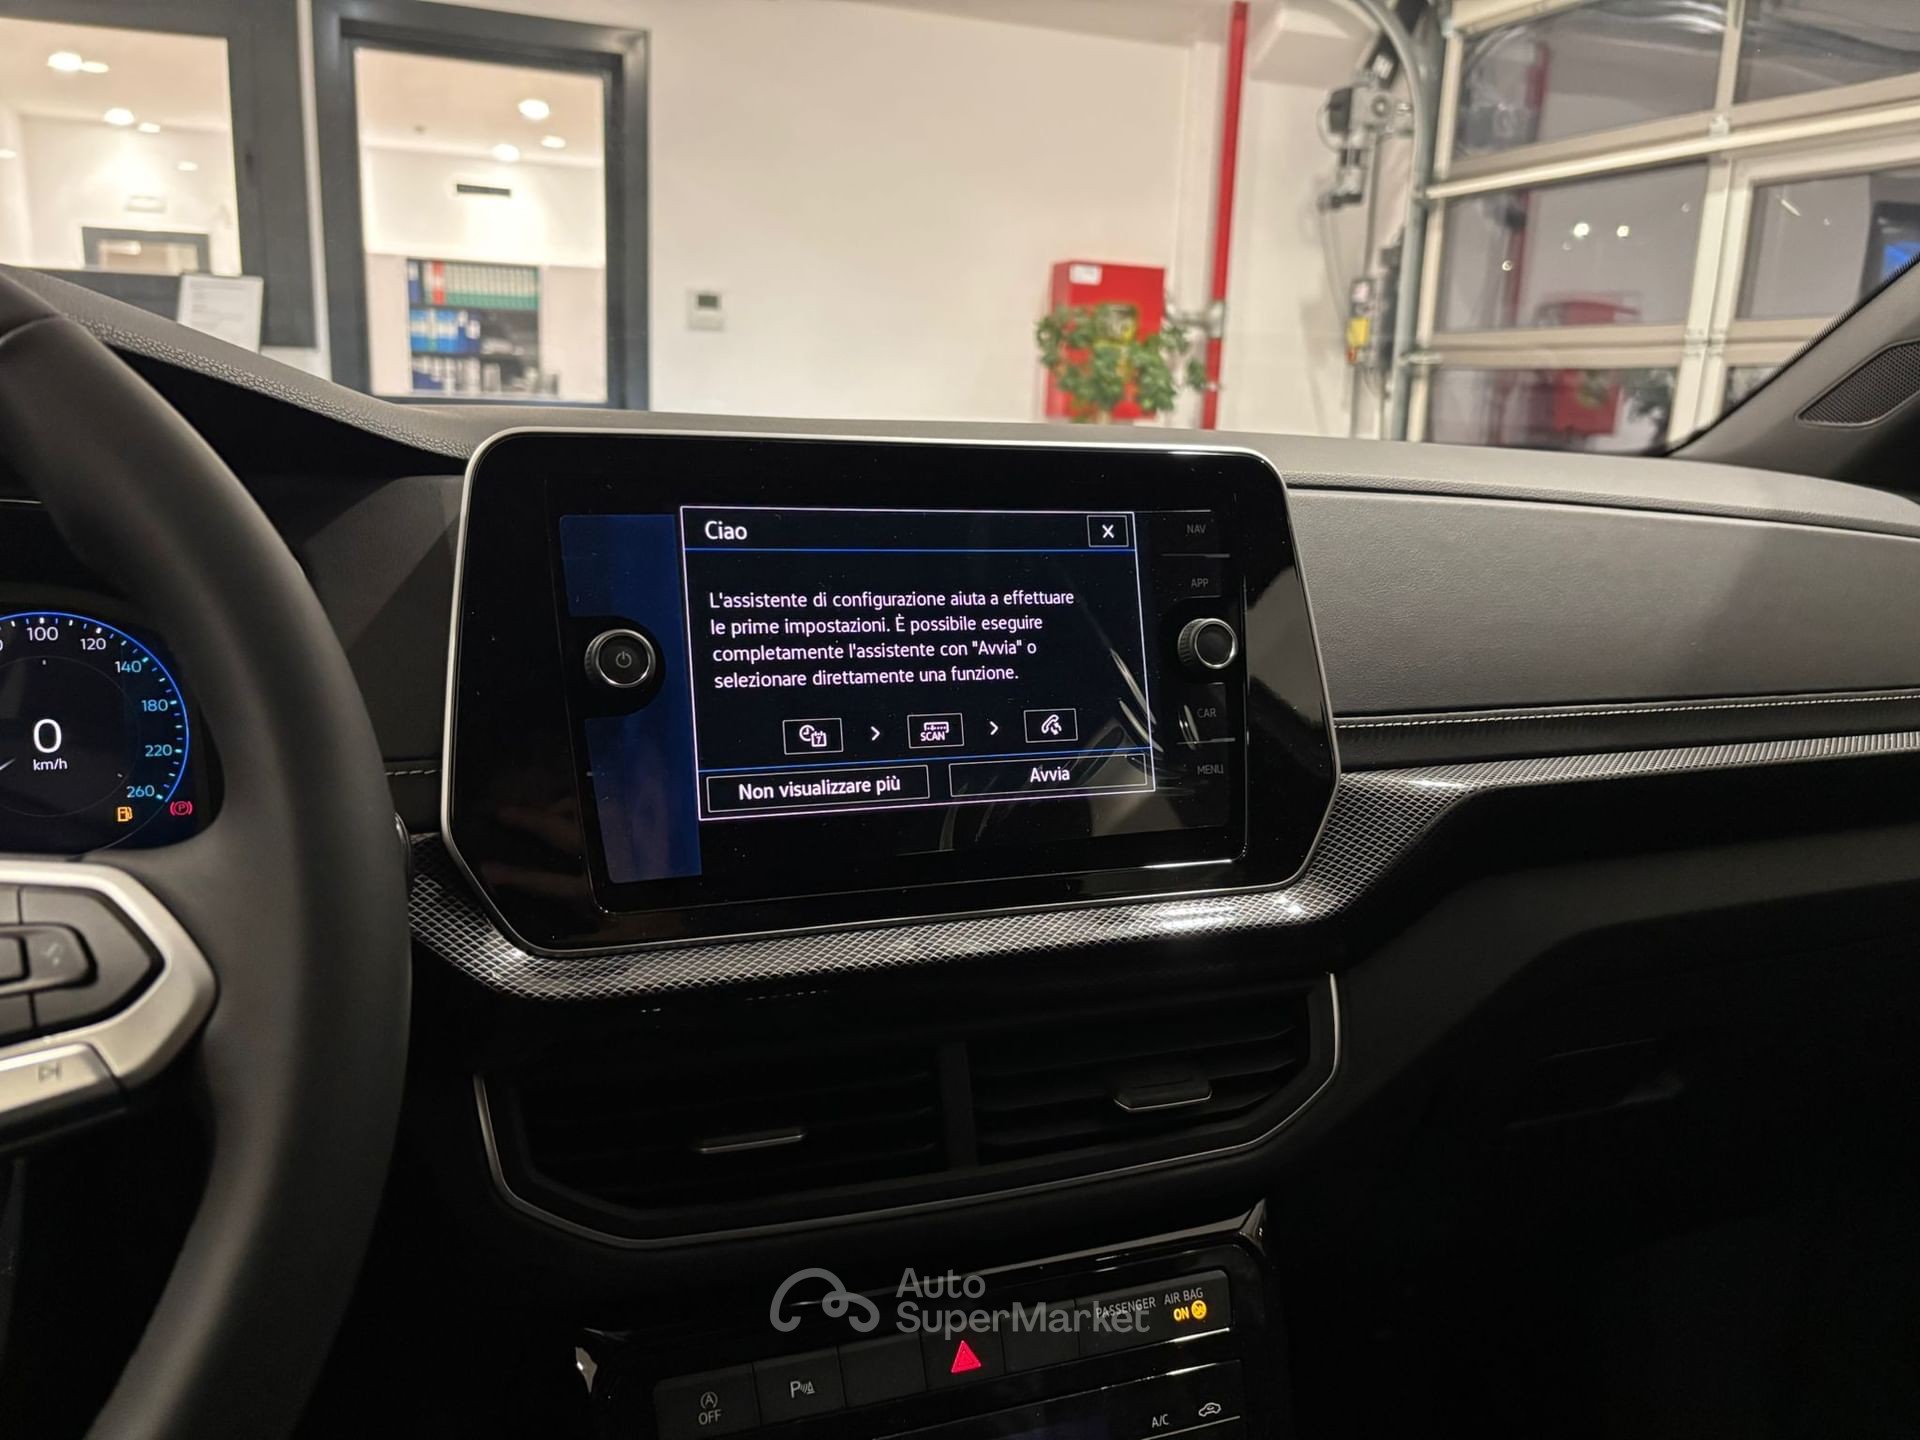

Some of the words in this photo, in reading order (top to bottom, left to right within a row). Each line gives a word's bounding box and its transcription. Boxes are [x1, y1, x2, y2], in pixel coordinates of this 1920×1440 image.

[704, 520, 748, 540] Ciao
[1187, 524, 1207, 535] NAV
[1191, 578, 1209, 589] APP
[709, 592, 808, 608] L'assistente
[813, 592, 827, 607] di
[832, 591, 946, 610] configurazione
[950, 590, 986, 606] aiuta
[1003, 590, 1074, 605] effettuare
[26, 626, 59, 641] 100
[711, 618, 726, 635] le
[731, 618, 780, 639] prime
[784, 617, 890, 637] impostazioni.
[895, 613, 906, 632] È
[910, 616, 977, 635] possibile
[981, 615, 1043, 633] eseguire
[80, 637, 107, 650] 120
[713, 645, 844, 664] completamente
[849, 643, 935, 659] l'assistente
[940, 643, 968, 656] con
[972, 640, 1022, 655] "Avvia"
[115, 660, 142, 673] 140
[714, 671, 807, 689] selezionare
[812, 669, 914, 686] direttamente
[919, 670, 947, 683] una
[951, 666, 1019, 682] funzione.
[141, 699, 169, 712] 180
[1197, 707, 1217, 719] CAR
[33, 718, 62, 754] 0
[920, 731, 946, 742] SCAN
[145, 744, 173, 757] 220
[32, 758, 68, 771] km/h
[1197, 764, 1224, 776] MENU
[1030, 766, 1071, 783] Avvia
[126, 784, 155, 798] 260
[738, 783, 774, 800] Non
[779, 778, 871, 798] visualizzare
[876, 775, 901, 796] più
[1095, 1296, 1157, 1319] PASSENGER
[1164, 1291, 1181, 1305] AIR
[1183, 1287, 1204, 1301] BAG
[1173, 1307, 1190, 1322] ON
[698, 1408, 722, 1425] OFF
[1151, 1413, 1169, 1428] A/C
